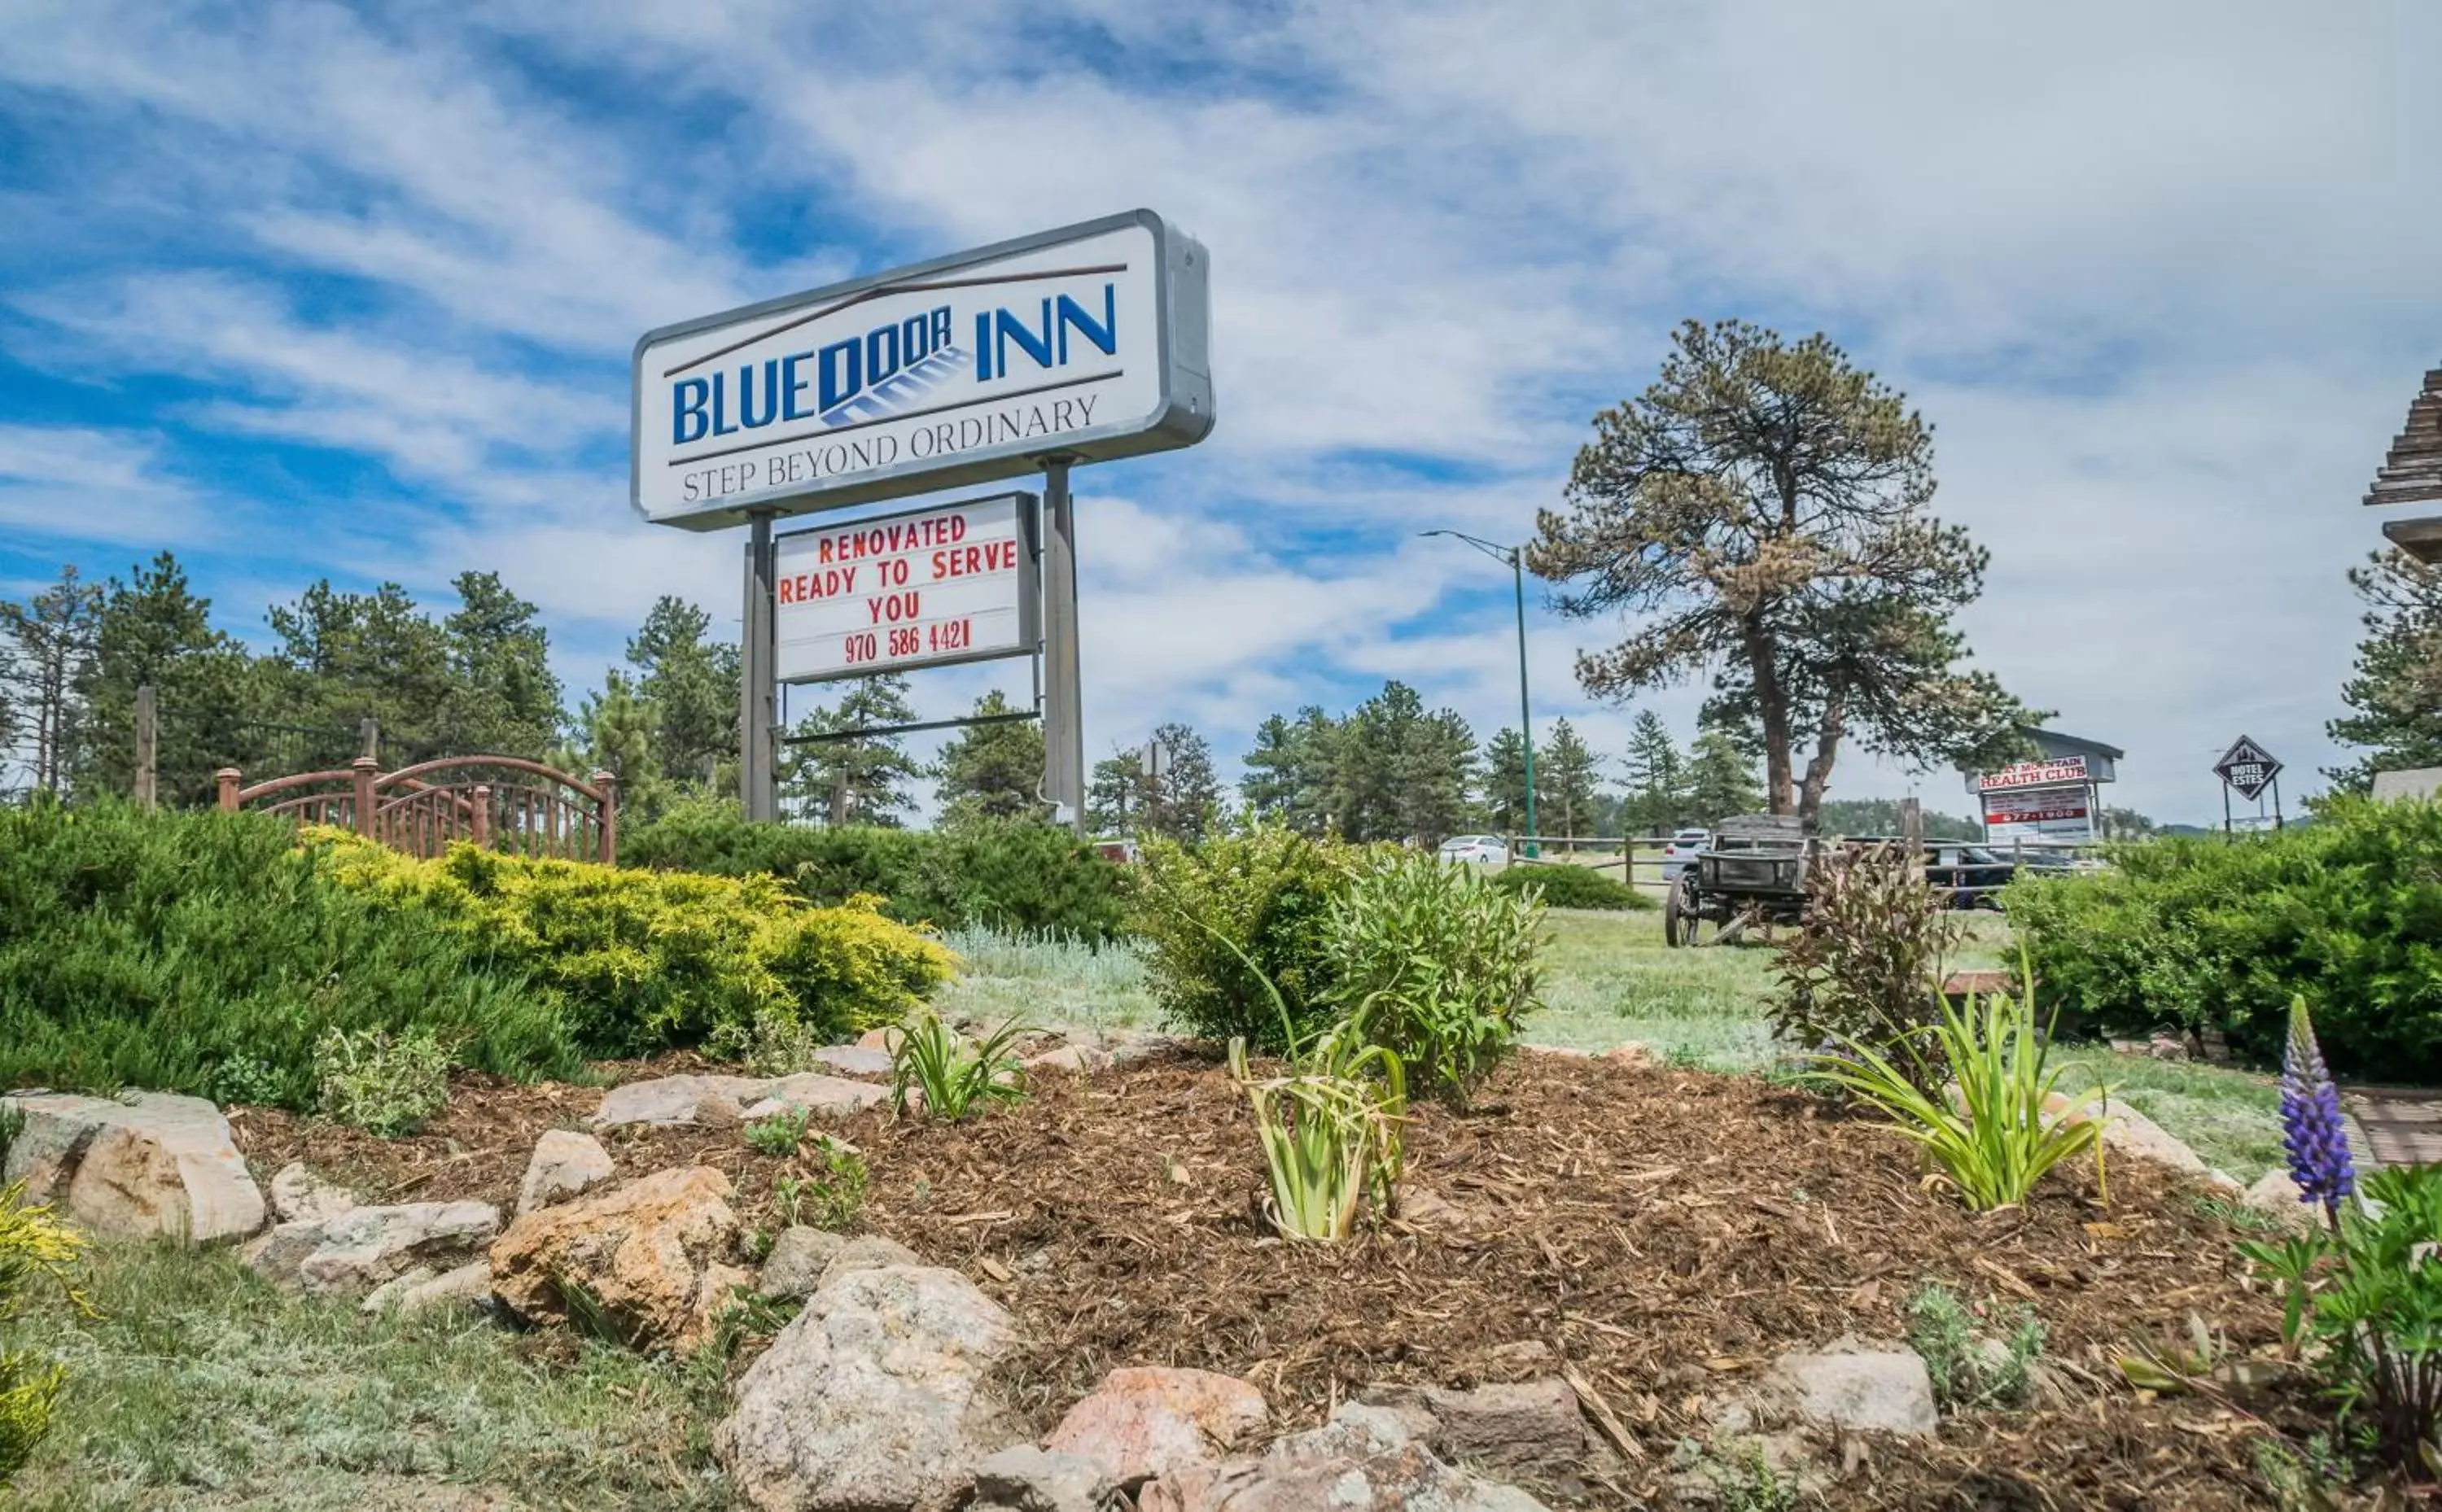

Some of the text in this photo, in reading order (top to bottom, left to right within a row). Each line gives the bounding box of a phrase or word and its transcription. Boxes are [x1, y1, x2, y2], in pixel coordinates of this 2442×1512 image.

[976, 282, 1116, 382] INN
[683, 395, 1097, 502] STEP BEYOND ORDINARY
[820, 514, 966, 564] RENOVATED
[780, 540, 1017, 604] READY TO SERVE
[868, 592, 920, 624] YOU
[845, 618, 971, 663] 970 586 4421
[1980, 766, 2085, 789] HEALTH CLUB
[2230, 763, 2265, 776] HOTEL
[2233, 774, 2264, 785] ESTES
